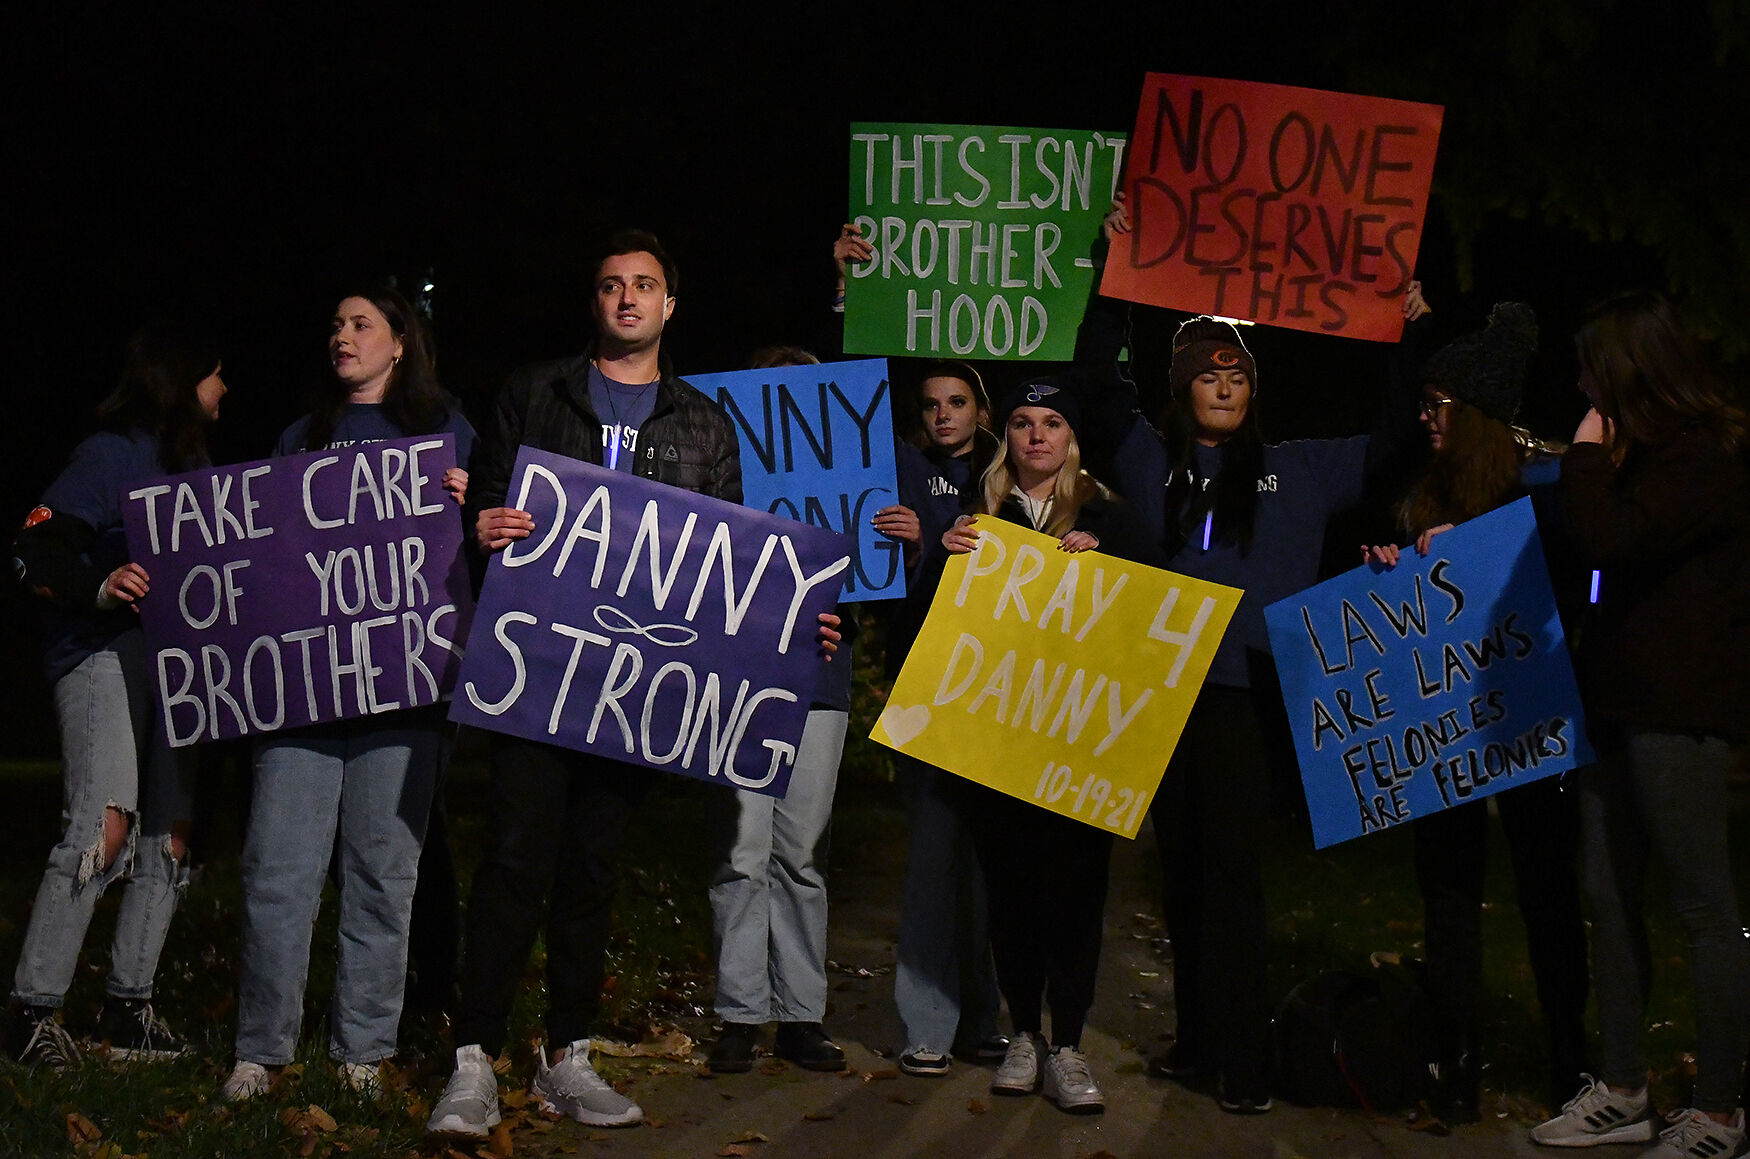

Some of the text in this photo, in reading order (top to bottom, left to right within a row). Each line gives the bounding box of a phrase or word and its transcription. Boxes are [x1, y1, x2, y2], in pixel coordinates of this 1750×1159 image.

[853, 131, 1126, 211] THIS ISN'T
[1150, 87, 1419, 208] NO ONE
[1130, 176, 1417, 300] DESERVES
[1201, 262, 1355, 331] THIS
[906, 289, 1048, 357] HOOD
[129, 440, 445, 554] TAKE CARE
[178, 537, 429, 630] OF YOUR
[502, 464, 851, 654] DANNY
[955, 529, 1218, 688] PRAY 4
[1301, 559, 1465, 676] LAWS
[157, 604, 465, 748] BROTHERS
[465, 611, 798, 788] STRONG
[934, 632, 1154, 757] DANNY
[1312, 611, 1533, 751] ARE LAWS
[1342, 689, 1507, 803] FELONIES
[1359, 716, 1568, 835] ARE FELONIES
